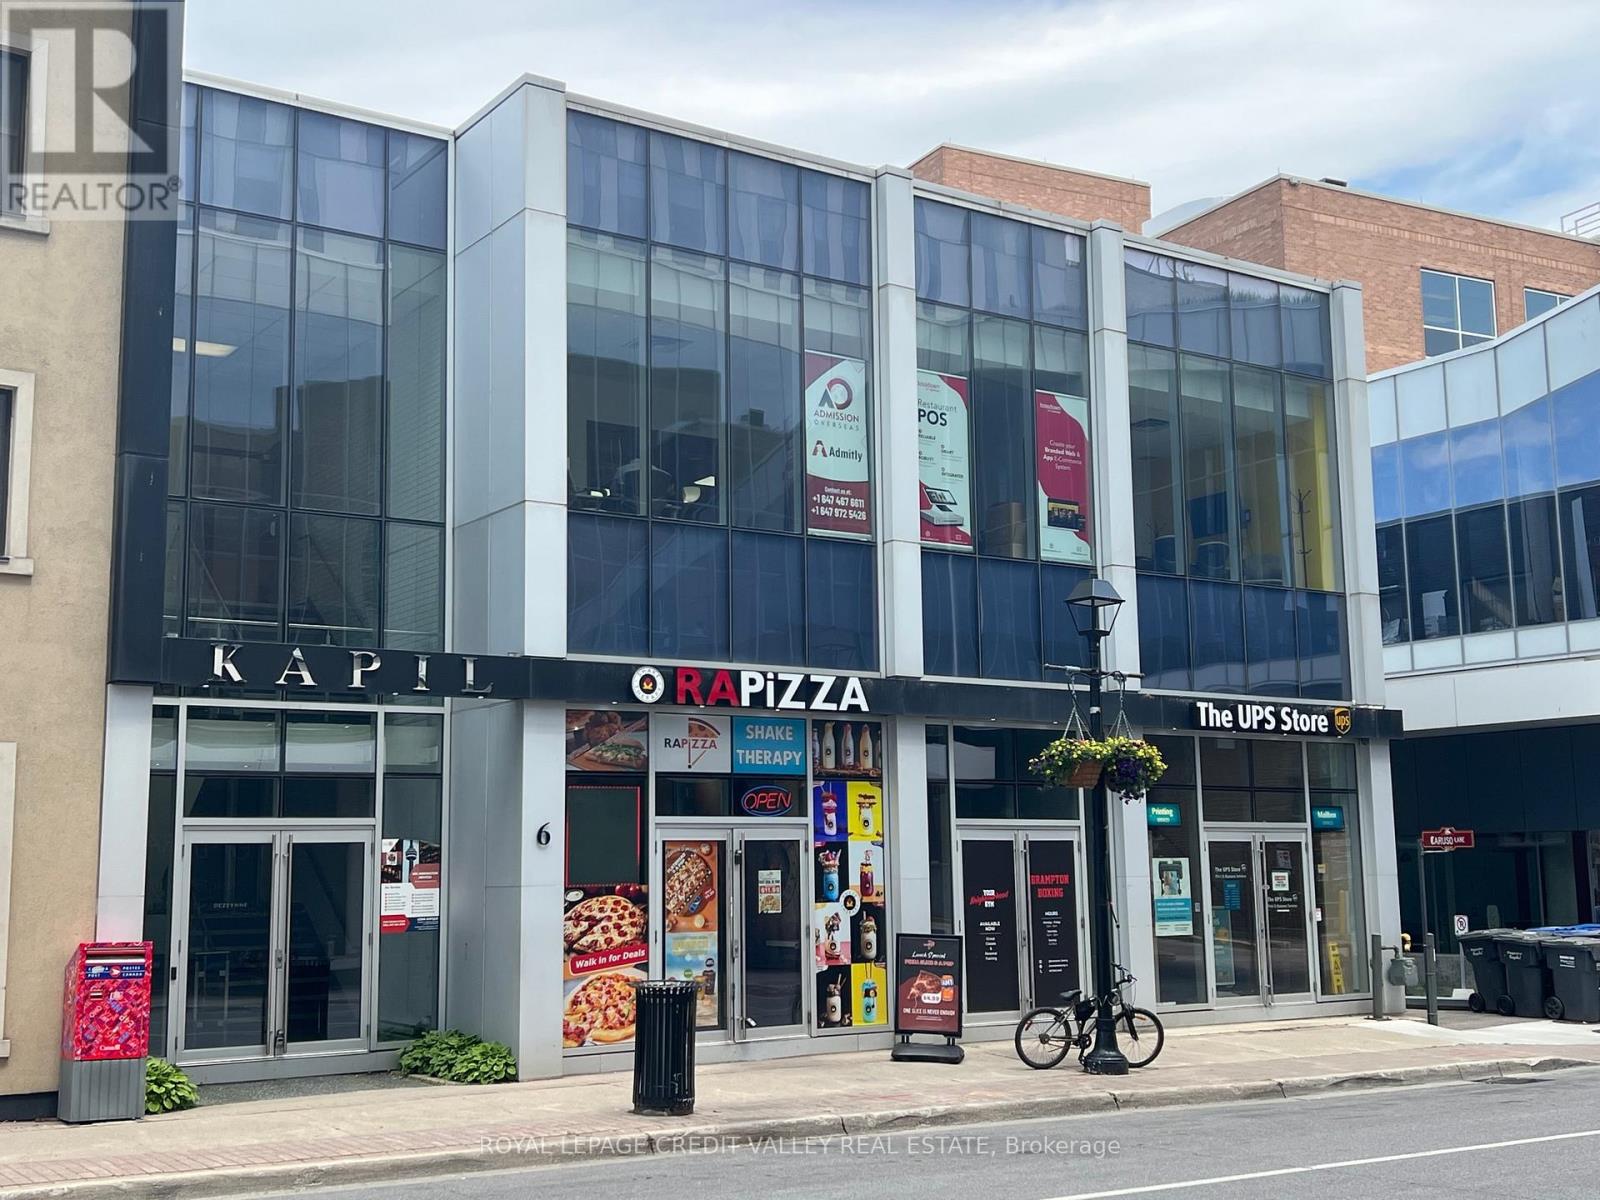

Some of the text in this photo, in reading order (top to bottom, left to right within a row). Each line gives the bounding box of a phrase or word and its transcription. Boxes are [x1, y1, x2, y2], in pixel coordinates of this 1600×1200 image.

[918, 399, 957, 412] Restaurant
[814, 410, 860, 422] ADMISSION
[918, 408, 947, 427] POS
[814, 419, 859, 431] OVERSEAS
[829, 446, 863, 462] Admitly
[1043, 454, 1053, 462] App
[208, 643, 493, 694] KAPIL
[1197, 702, 1328, 732] The UPS Store
[1336, 715, 1350, 730] ups
[746, 725, 793, 741] SHAKE
[736, 749, 802, 766] THERAPY
[744, 791, 792, 809] OPEN
[1151, 807, 1174, 817] Printing
[536, 822, 551, 846] 6
[1030, 875, 1069, 884] BRAMPTON
[1037, 888, 1064, 897] BOXING
[575, 958, 598, 969] Walk
[608, 953, 622, 963] for
[623, 949, 646, 960] Deals
